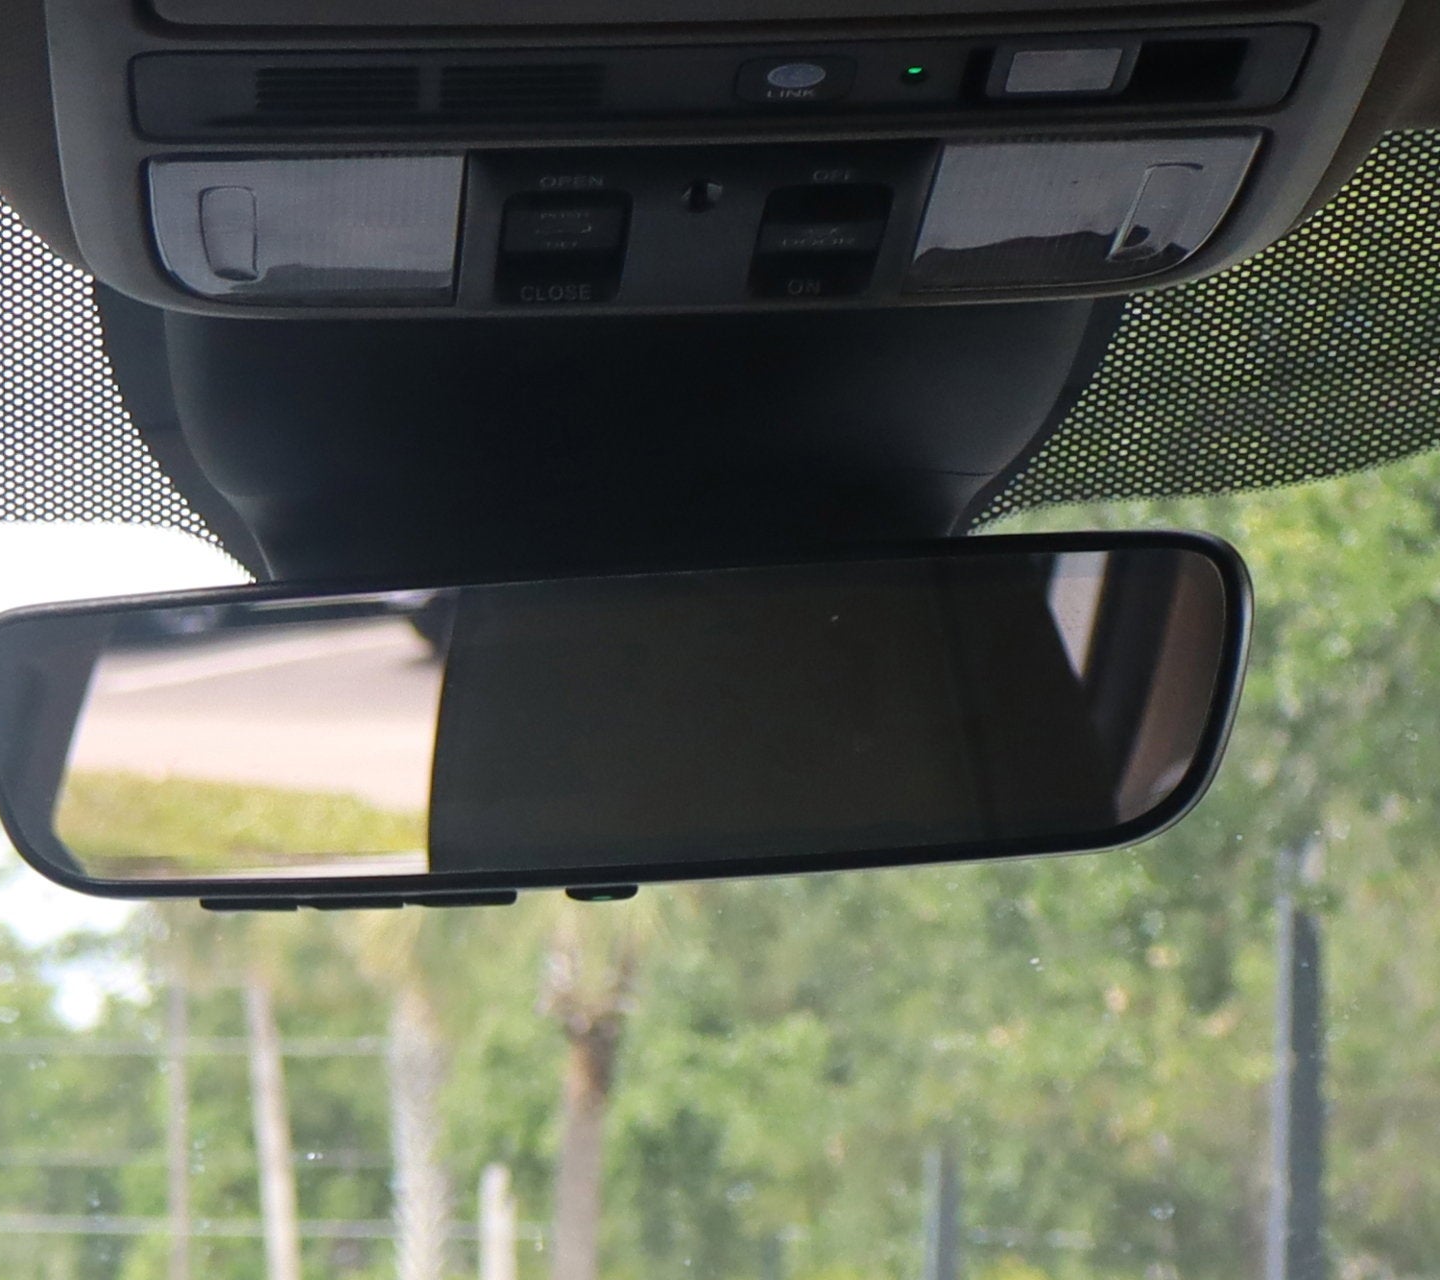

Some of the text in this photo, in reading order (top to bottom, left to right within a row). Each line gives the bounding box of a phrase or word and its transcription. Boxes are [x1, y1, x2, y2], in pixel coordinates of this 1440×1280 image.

[766, 88, 817, 99] LINK
[538, 174, 605, 187] OPEN
[519, 284, 592, 302] CLOSE
